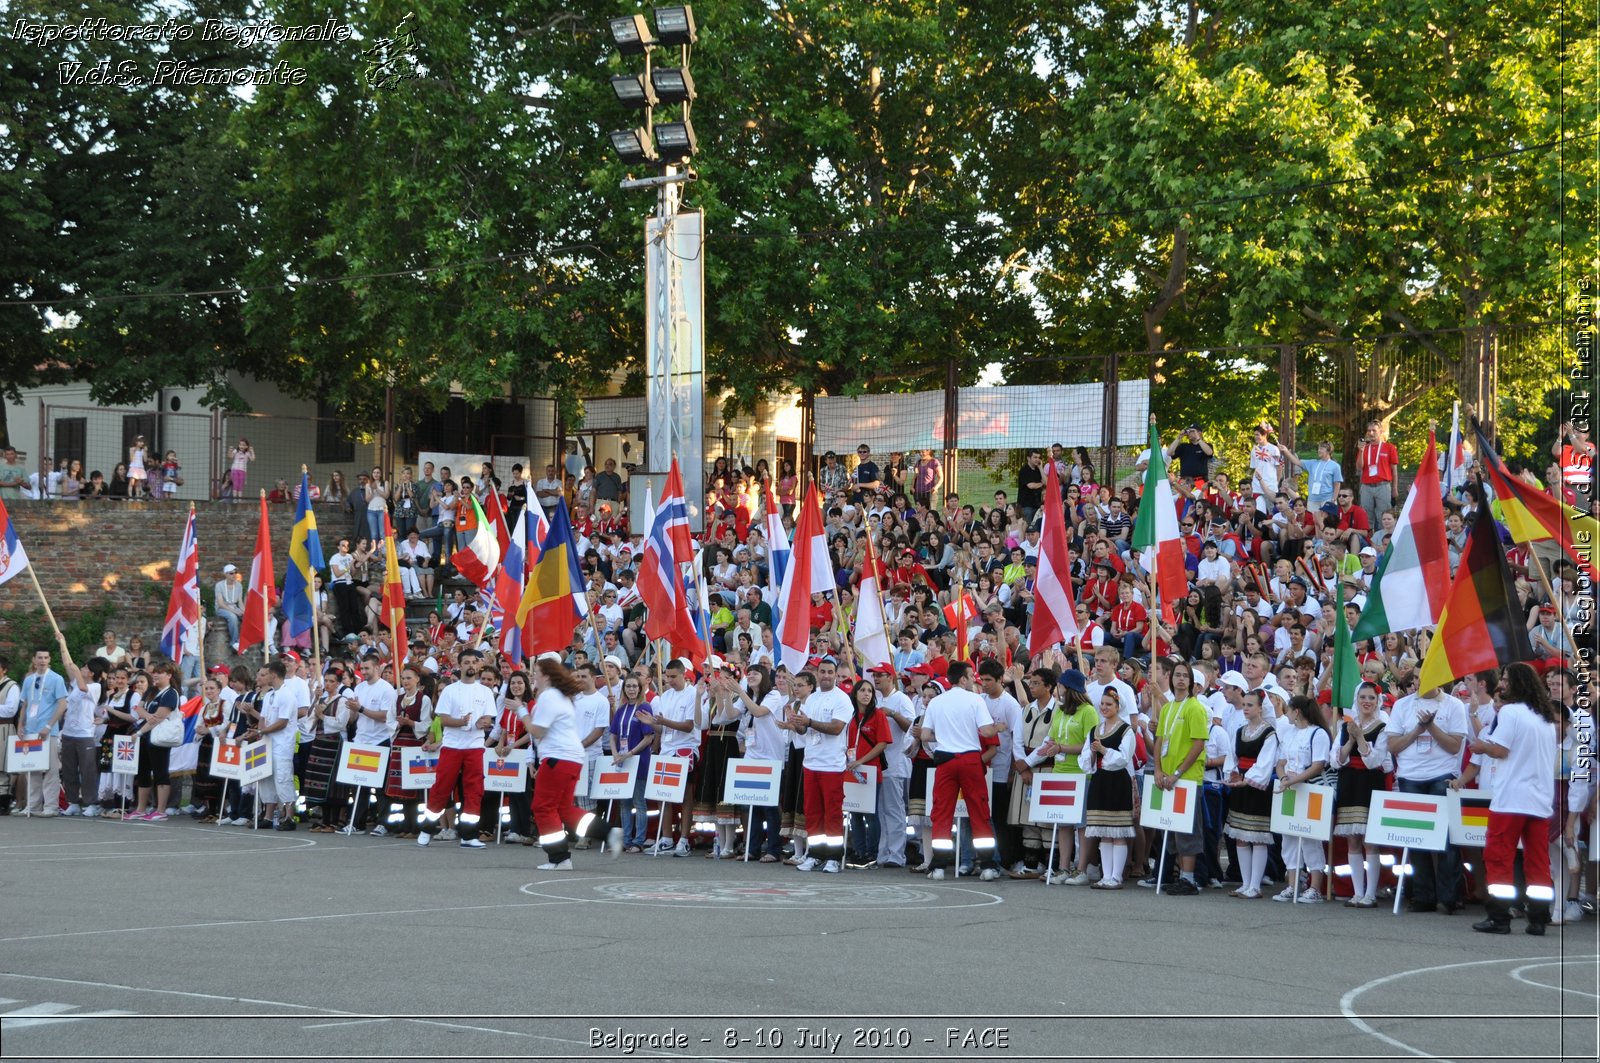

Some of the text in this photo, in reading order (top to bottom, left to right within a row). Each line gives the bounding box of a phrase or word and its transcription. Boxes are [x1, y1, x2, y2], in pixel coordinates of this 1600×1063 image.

[492, 780, 513, 788] Slovakia
[603, 788, 620, 796] Poland
[656, 789, 673, 798] Norway
[734, 793, 769, 802] Netherlands
[1046, 811, 1064, 820] Latvia
[1159, 816, 1174, 826] Italy
[1288, 823, 1312, 834] Ireland
[1387, 832, 1425, 845] Hungary
